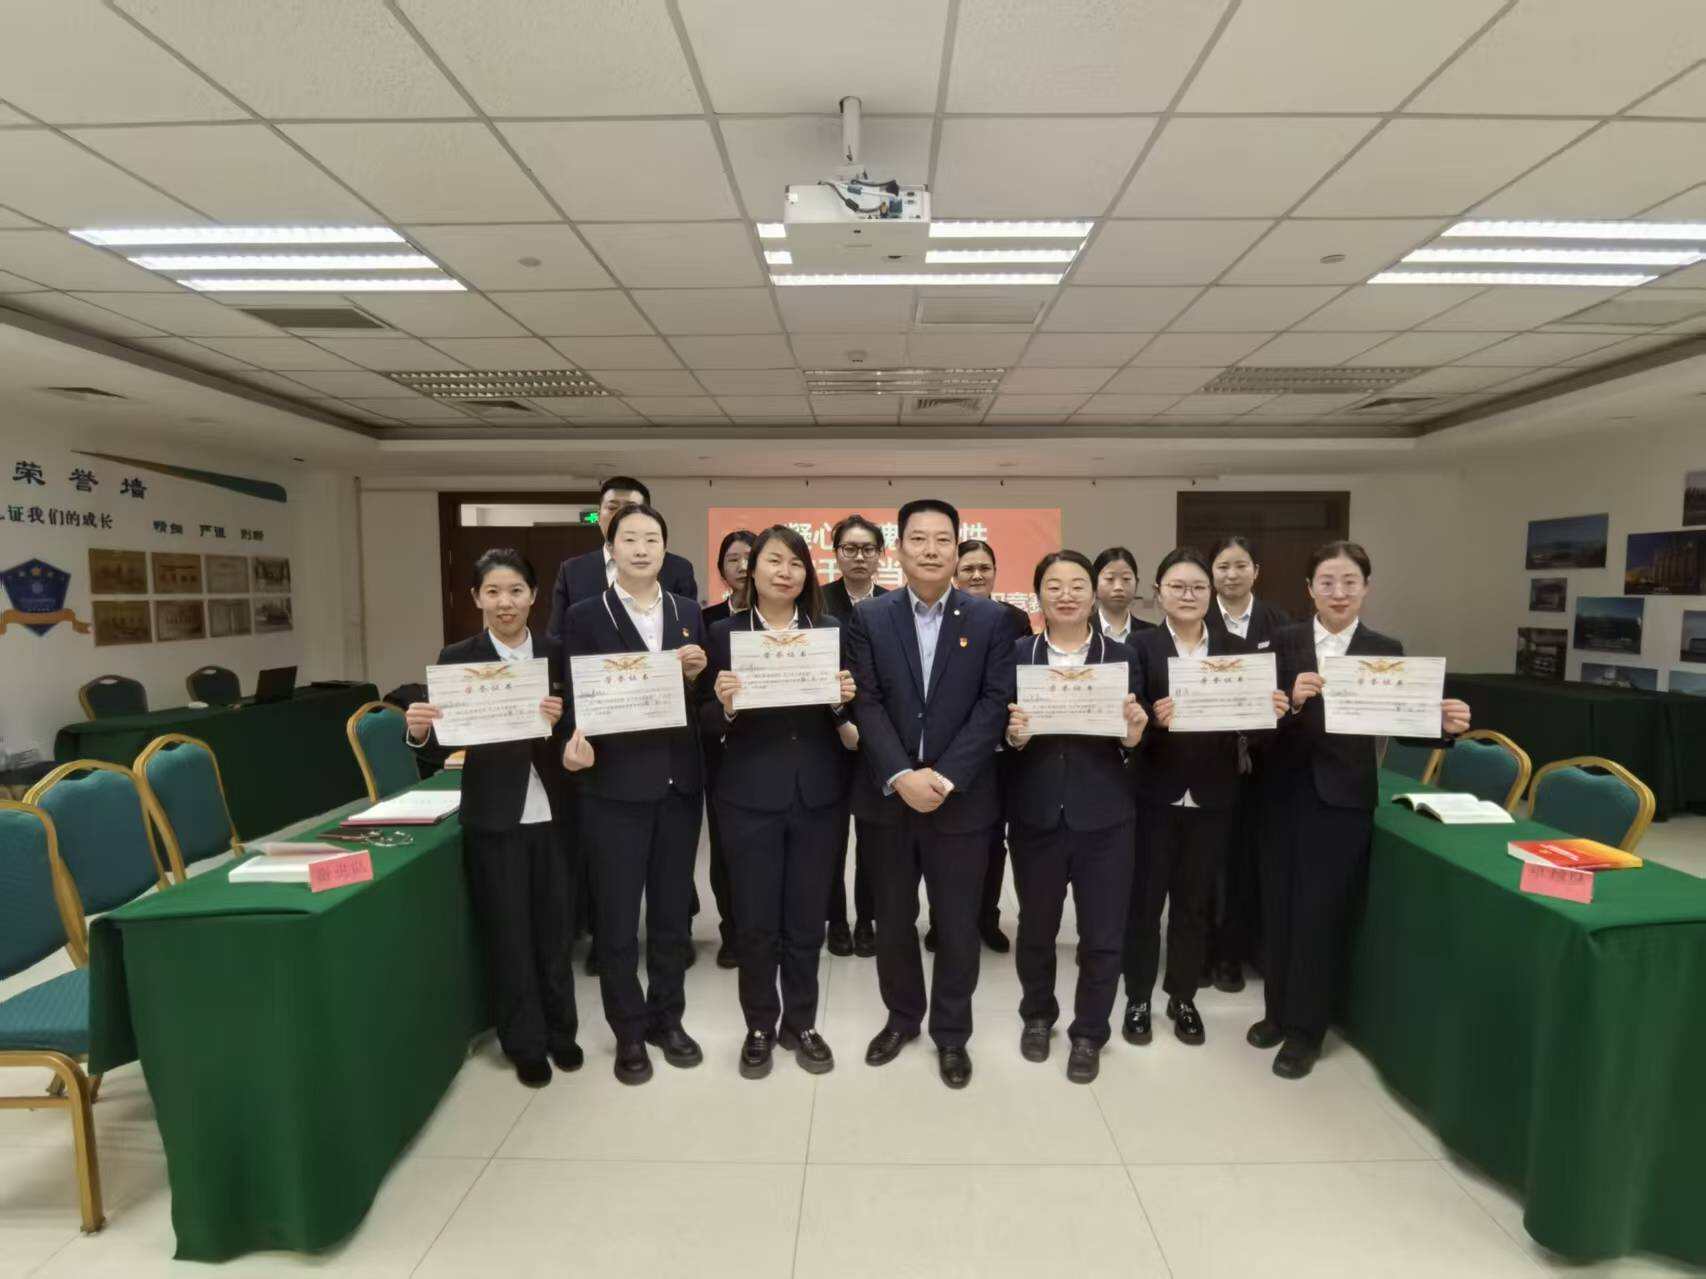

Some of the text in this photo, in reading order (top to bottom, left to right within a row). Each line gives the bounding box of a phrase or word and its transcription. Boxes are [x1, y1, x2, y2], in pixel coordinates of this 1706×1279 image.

[12, 460, 147, 499] 荣誉墙
[0, 504, 113, 529] 证我们的成长
